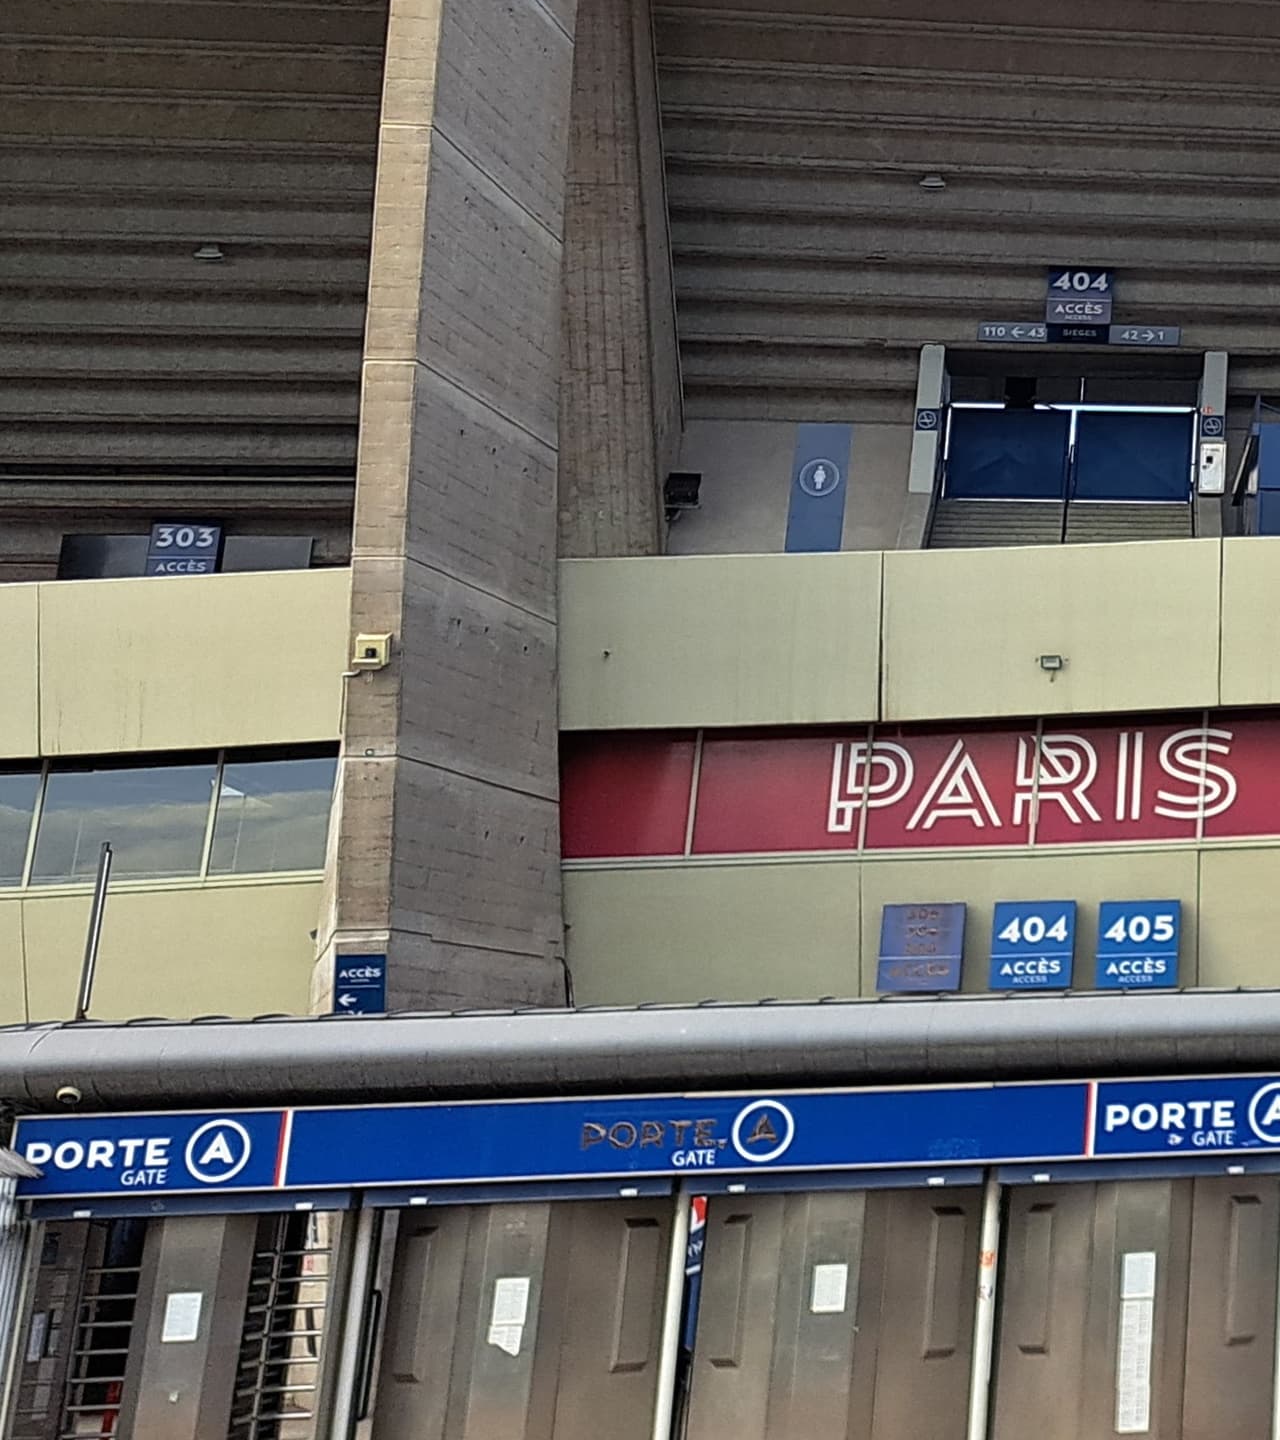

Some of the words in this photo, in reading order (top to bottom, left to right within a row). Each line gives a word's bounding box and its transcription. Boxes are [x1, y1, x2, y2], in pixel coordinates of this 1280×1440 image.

[1052, 271, 1109, 292] 404
[1055, 301, 1104, 315] ACCÈS
[983, 326, 1006, 338] 110
[1027, 327, 1046, 338] 43
[1121, 329, 1139, 340] 42
[1158, 330, 1164, 340] 1
[155, 527, 215, 548] 303
[155, 559, 208, 573] ACCÈS
[827, 728, 1238, 833] PARIS
[998, 915, 1068, 943] 404
[1103, 915, 1174, 943] 405
[339, 965, 382, 979] ACCÈS
[1000, 957, 1061, 975] ACCÈS
[1105, 957, 1167, 975] ACCÈS
[1104, 1099, 1236, 1132] PORTE
[580, 1118, 719, 1152] PORTE
[745, 1113, 780, 1144] A
[1191, 1130, 1236, 1147] GATE
[24, 1137, 172, 1171] PORTE
[198, 1131, 236, 1165] A
[670, 1148, 716, 1167] GATE
[119, 1168, 168, 1187] GATE
